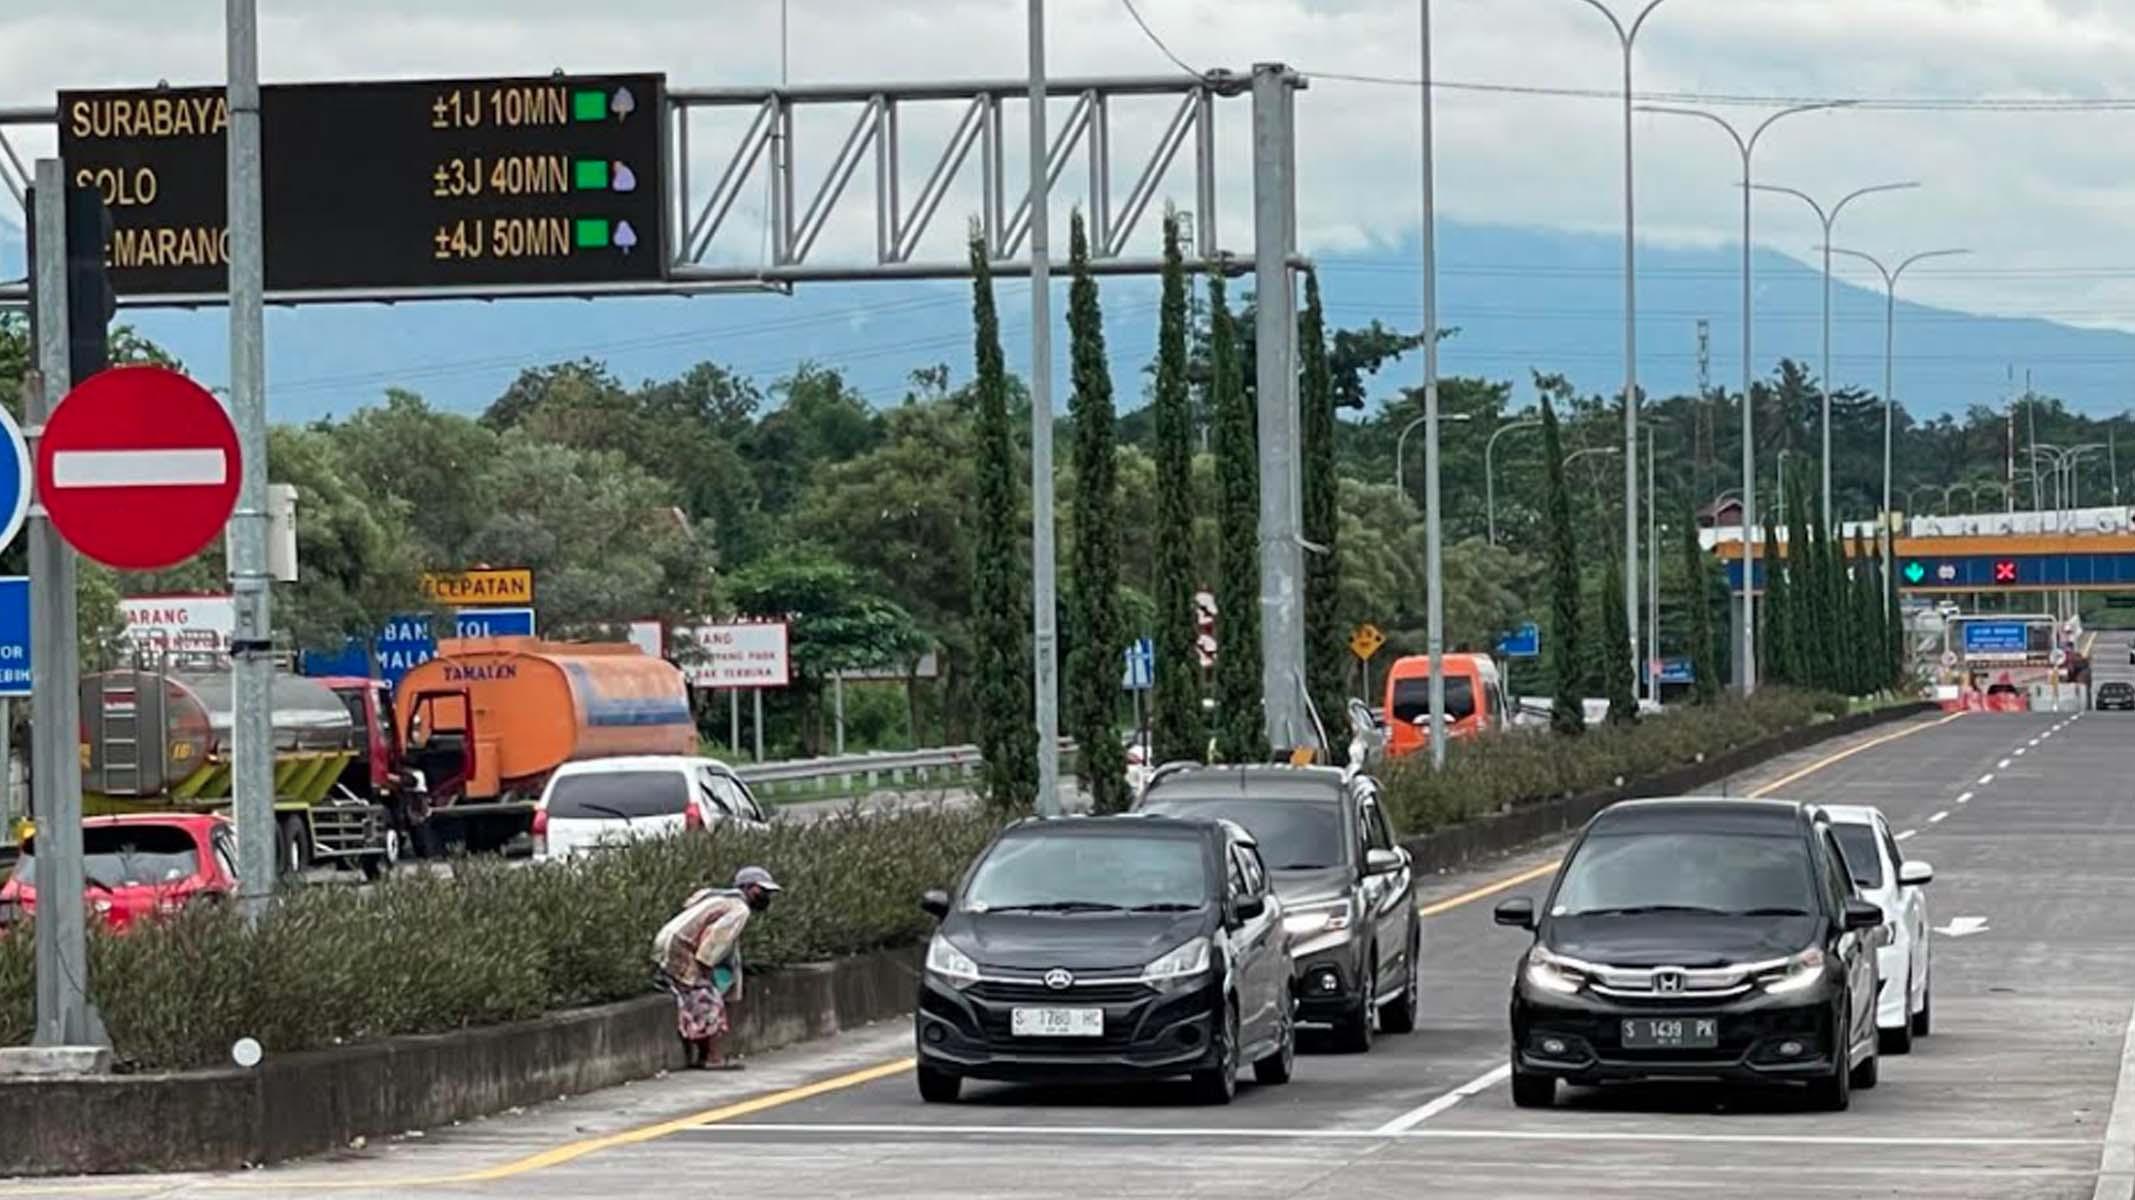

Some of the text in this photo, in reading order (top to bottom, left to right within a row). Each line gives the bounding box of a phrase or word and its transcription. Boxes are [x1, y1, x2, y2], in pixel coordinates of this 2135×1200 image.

[72, 87, 567, 137] SURABAYA ±1J 10MN
[434, 157, 482, 196] ±3J
[491, 156, 568, 194] 40MN
[105, 217, 570, 268] MARAN ±4J 50MN
[1015, 1008, 1025, 1027] S
[1624, 1021, 1636, 1038] S
